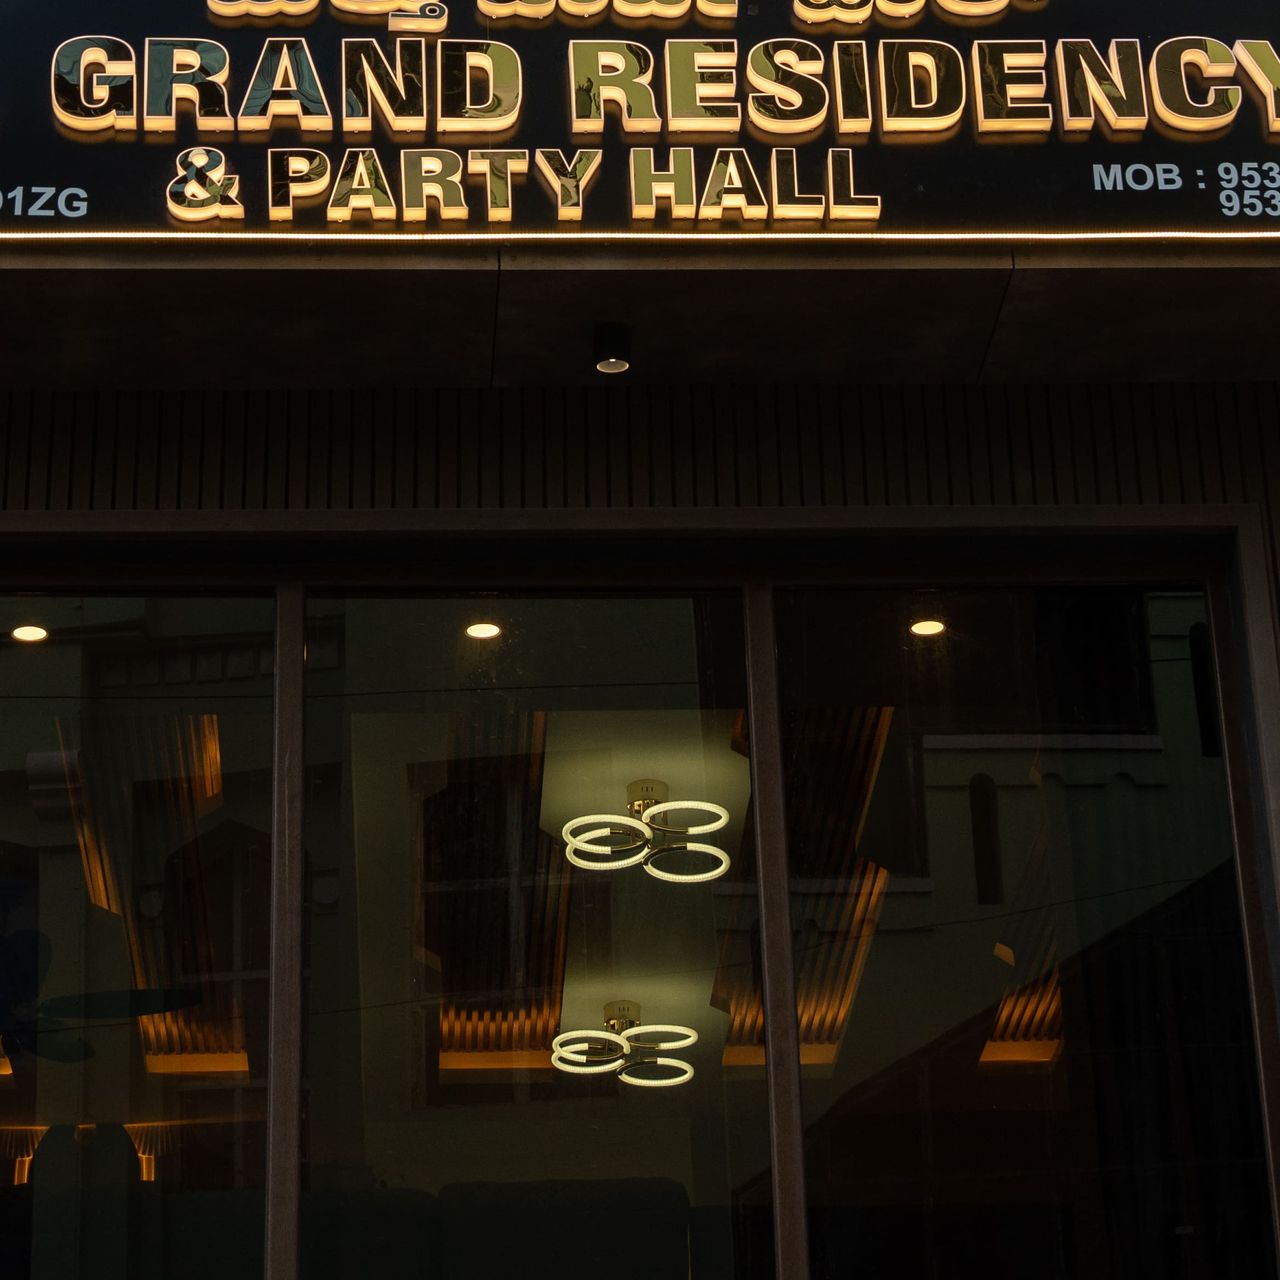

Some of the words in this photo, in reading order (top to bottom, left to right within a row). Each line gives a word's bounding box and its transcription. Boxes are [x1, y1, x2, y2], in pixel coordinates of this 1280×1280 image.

[51, 35, 523, 132] GRAND
[166, 146, 245, 221] &
[268, 147, 602, 221] PARTY
[629, 146, 881, 220] HALL
[1092, 163, 1183, 191] MOB
